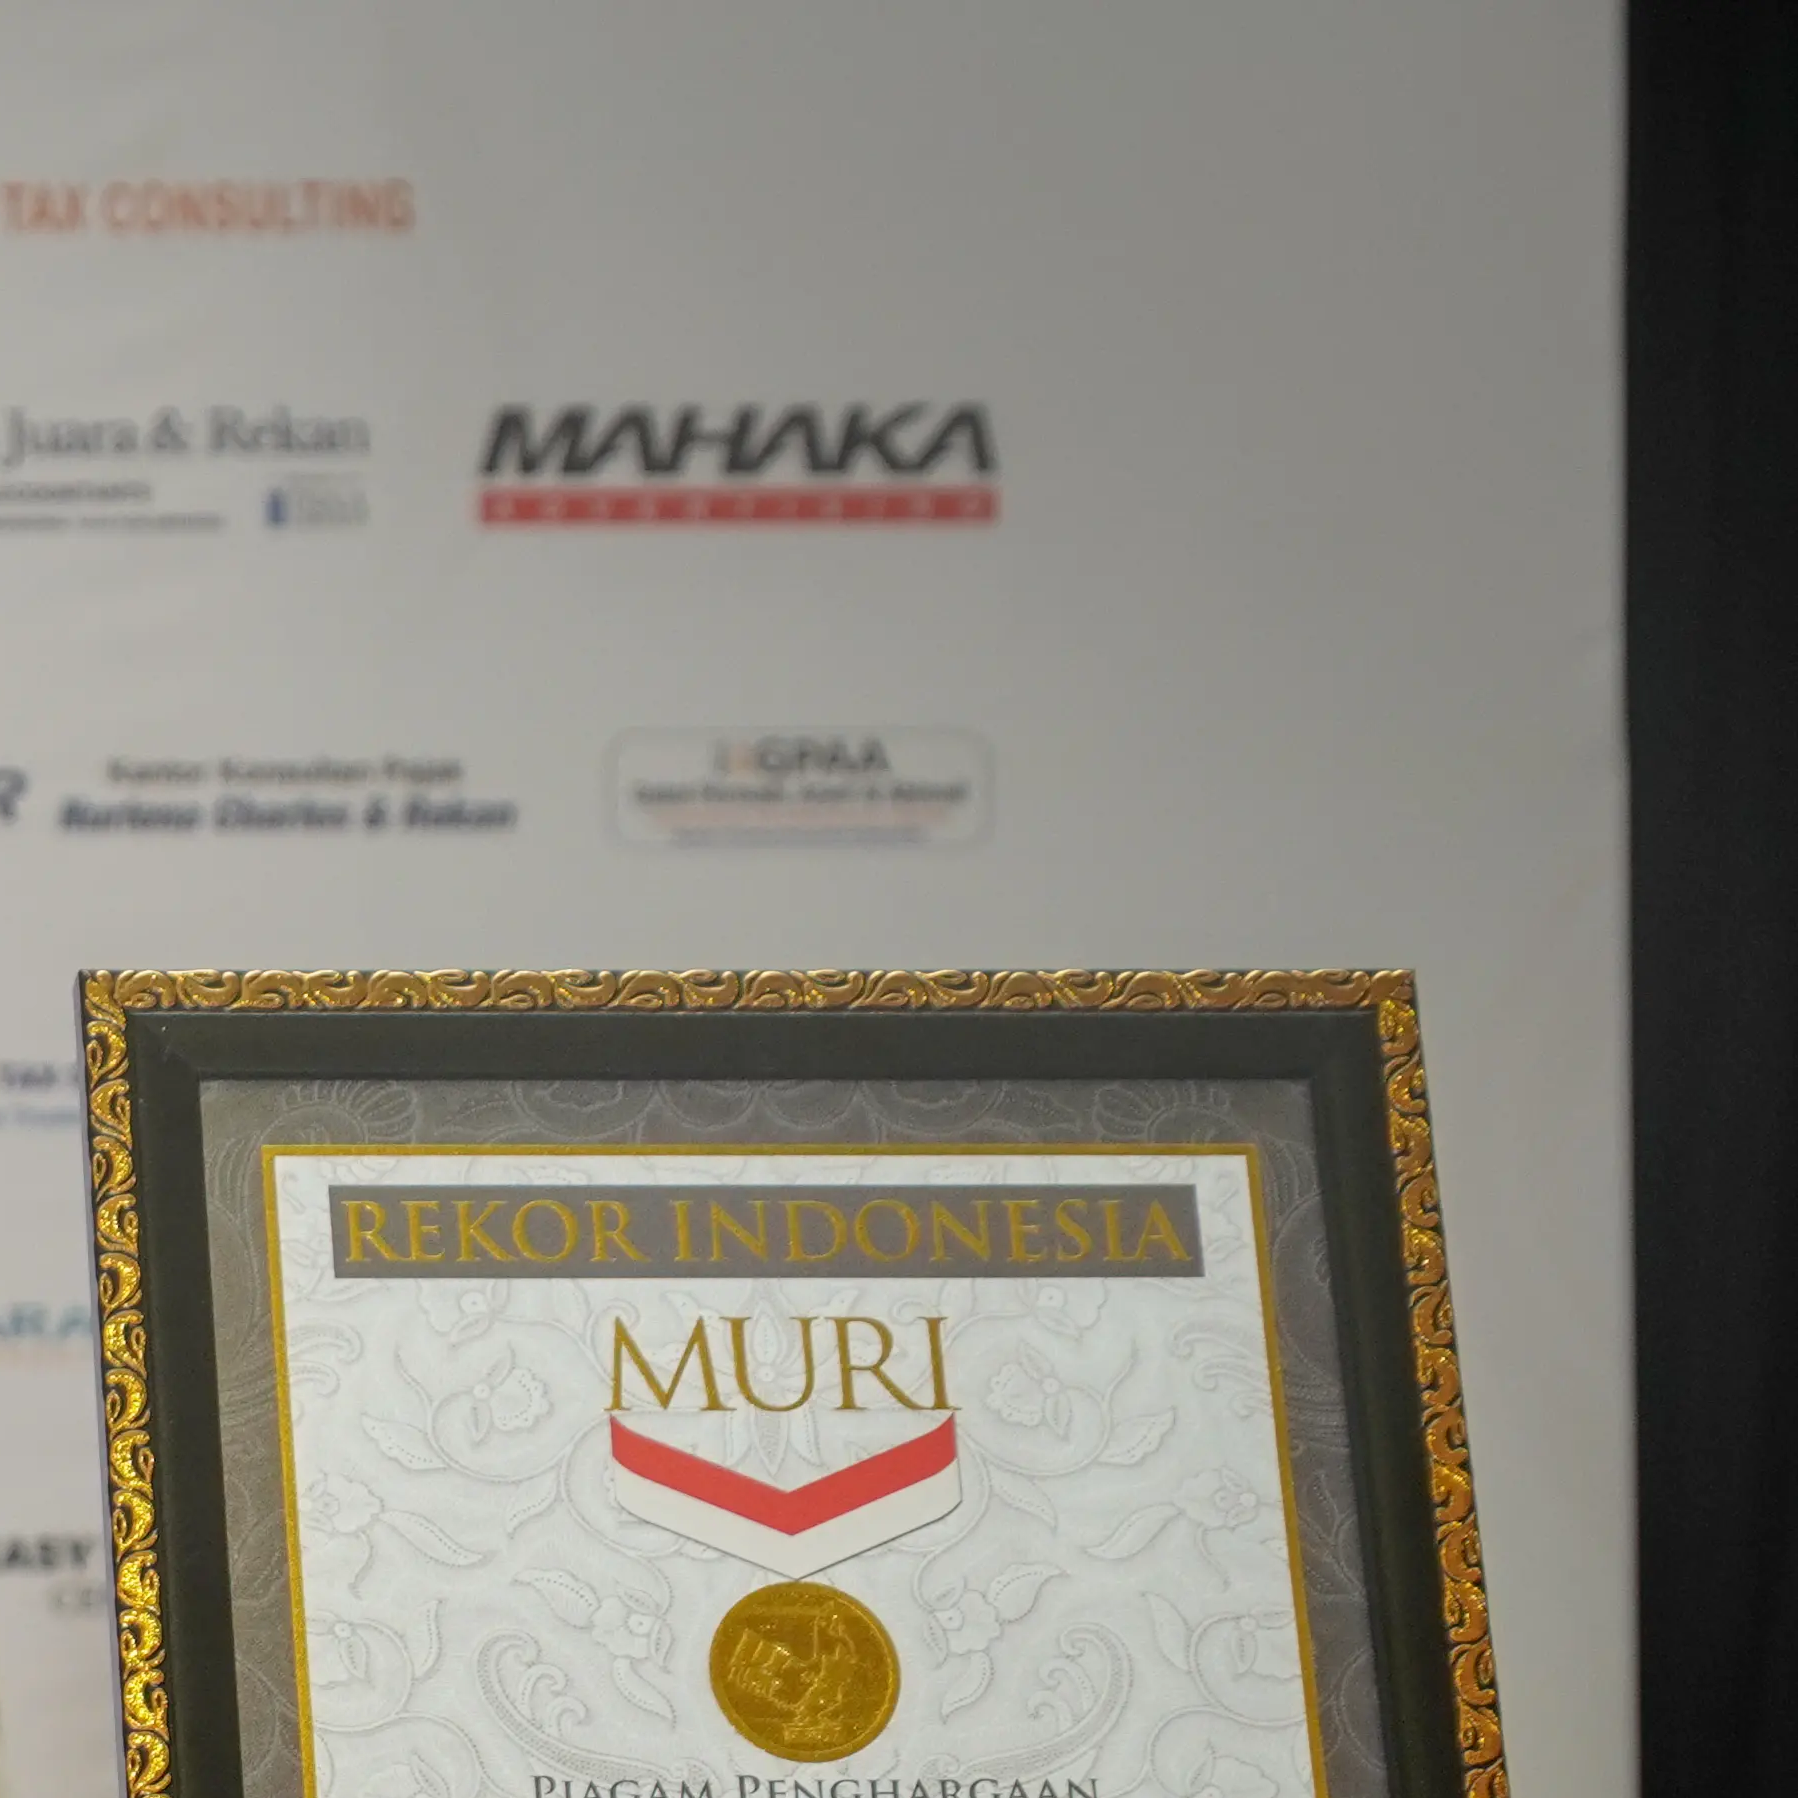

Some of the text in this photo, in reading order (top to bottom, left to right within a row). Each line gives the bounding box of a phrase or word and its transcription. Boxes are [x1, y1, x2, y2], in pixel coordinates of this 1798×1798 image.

[1, 180, 82, 232] TAX
[102, 178, 415, 235] CONSULTING
[2, 405, 139, 468] Juara
[146, 407, 190, 454] &
[207, 404, 371, 454] Rekan
[482, 401, 998, 474] MAHAKA
[345, 1198, 1190, 1264] REKOR INDONESIA
[605, 1316, 956, 1412] MURI
